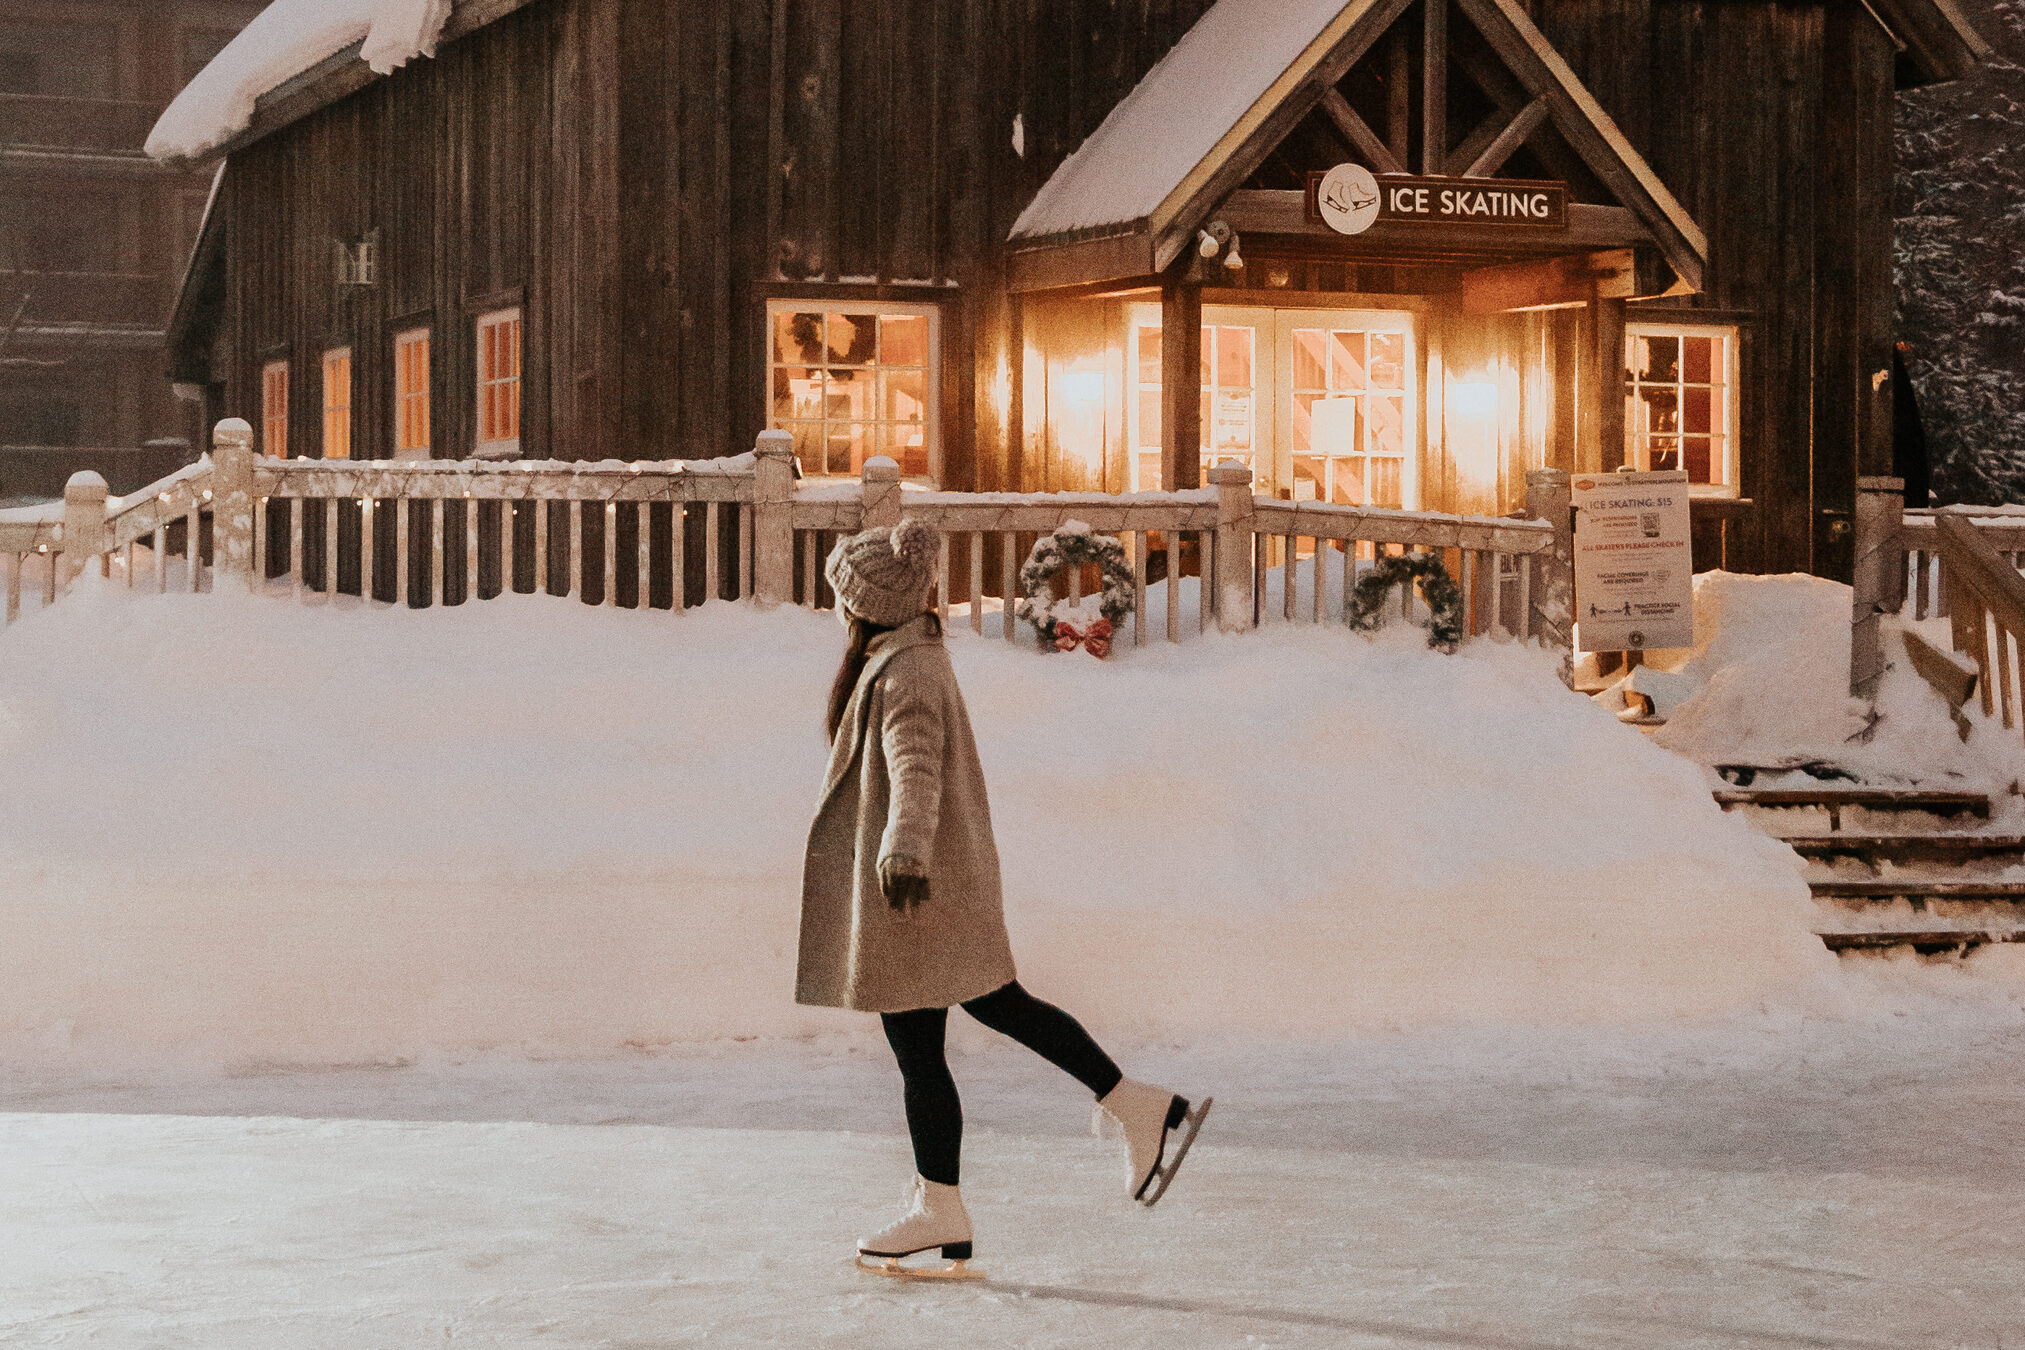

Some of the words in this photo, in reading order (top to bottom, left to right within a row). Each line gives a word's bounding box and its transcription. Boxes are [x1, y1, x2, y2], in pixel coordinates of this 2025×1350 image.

[1390, 188, 1430, 213] ICE
[1440, 190, 1549, 218] SKATING
[1590, 502, 1606, 510] ICE
[1657, 498, 1673, 506] $15
[1596, 542, 1624, 551] SKATERS
[1626, 542, 1650, 550] PLEASE
